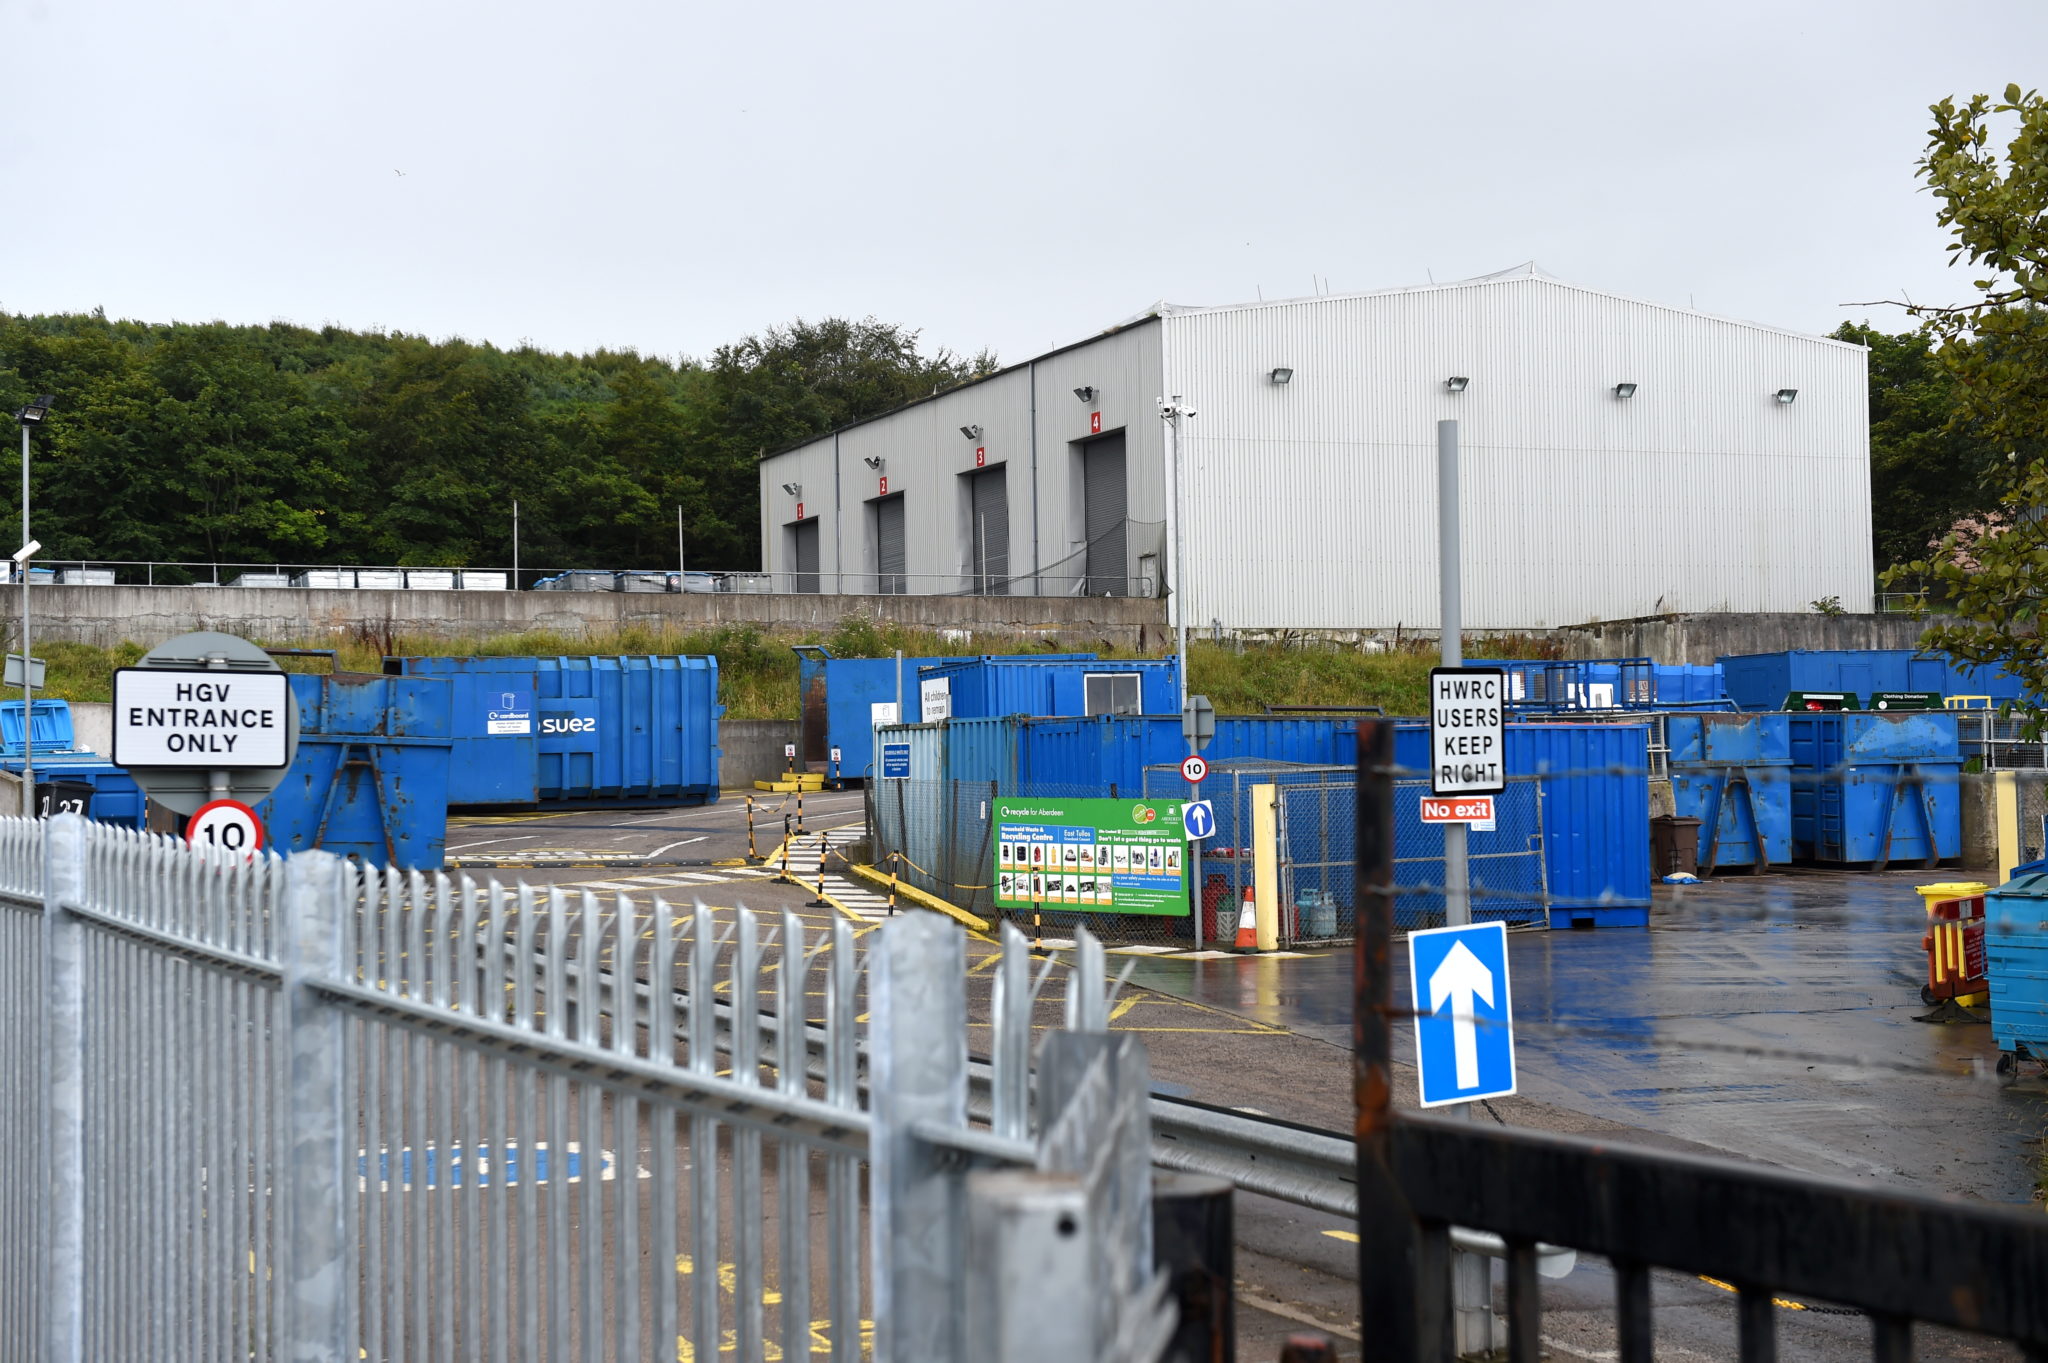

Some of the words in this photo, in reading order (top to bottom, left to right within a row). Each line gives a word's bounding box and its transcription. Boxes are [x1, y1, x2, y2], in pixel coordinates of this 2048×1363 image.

[1093, 416, 1099, 429] 4
[977, 452, 983, 463] 3
[881, 480, 886, 491] 2
[798, 506, 802, 517] 1
[177, 683, 230, 702] HGV
[1440, 680, 1495, 700] HWRC
[130, 708, 273, 728] ENTRANCE
[543, 718, 595, 733] suez
[1438, 708, 1498, 727] USERS
[167, 733, 238, 753] ONLY
[1445, 736, 1492, 755] KEEP
[1187, 764, 1202, 774] 10
[1442, 763, 1497, 784] RIGHT
[60, 799, 83, 815] 27
[1010, 808, 1029, 817] recycle
[1039, 808, 1064, 816] Aberdeen
[1424, 802, 1450, 817] No
[1455, 801, 1488, 816] exit
[204, 822, 245, 851] 10
[1001, 832, 1030, 841] Recycling
[1032, 833, 1054, 841] Centre
